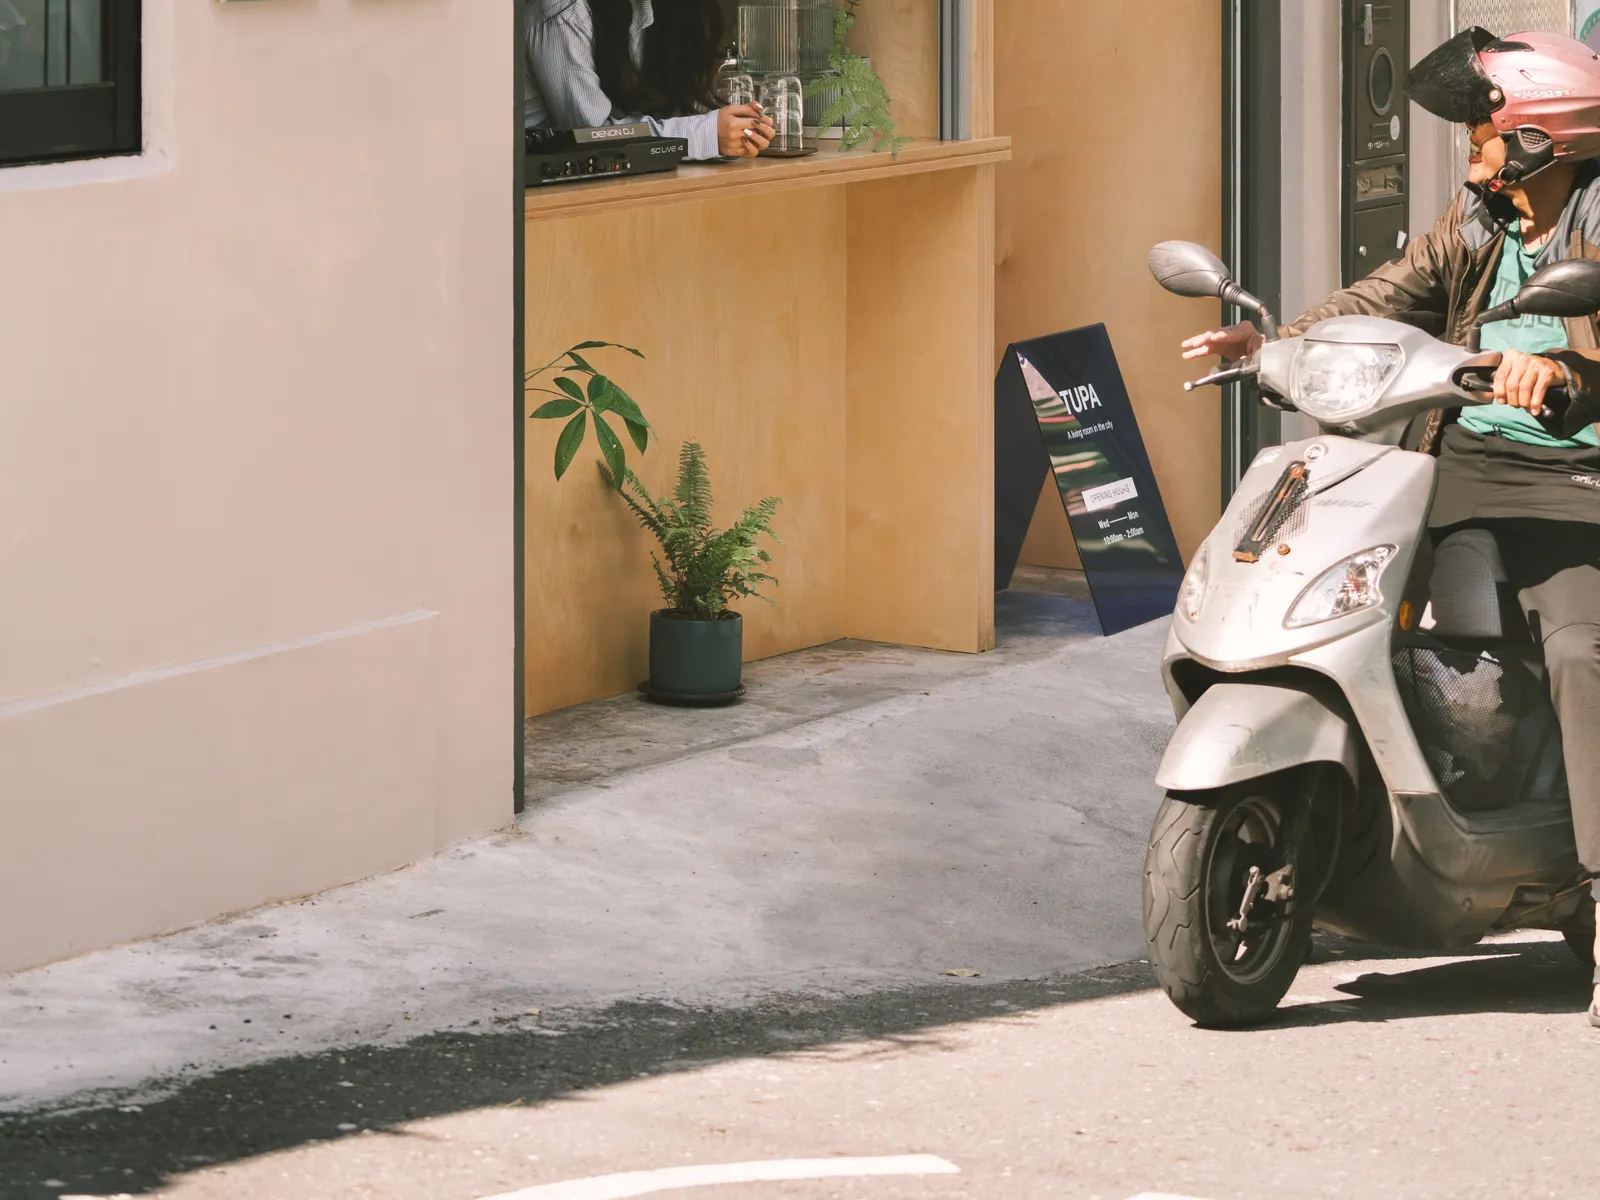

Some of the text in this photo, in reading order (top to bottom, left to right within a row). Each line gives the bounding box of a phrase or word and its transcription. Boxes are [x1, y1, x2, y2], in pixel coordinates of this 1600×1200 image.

[591, 127, 635, 139] DENON DJ
[650, 147, 660, 155] SC
[661, 145, 677, 153] LIVE
[1058, 383, 1102, 415] TUPA
[1067, 420, 1114, 440] A living room in the city
[1571, 474, 1600, 487] adid
[1089, 489, 1113, 503] OPENING
[1097, 511, 1140, 529] Wed Mon
